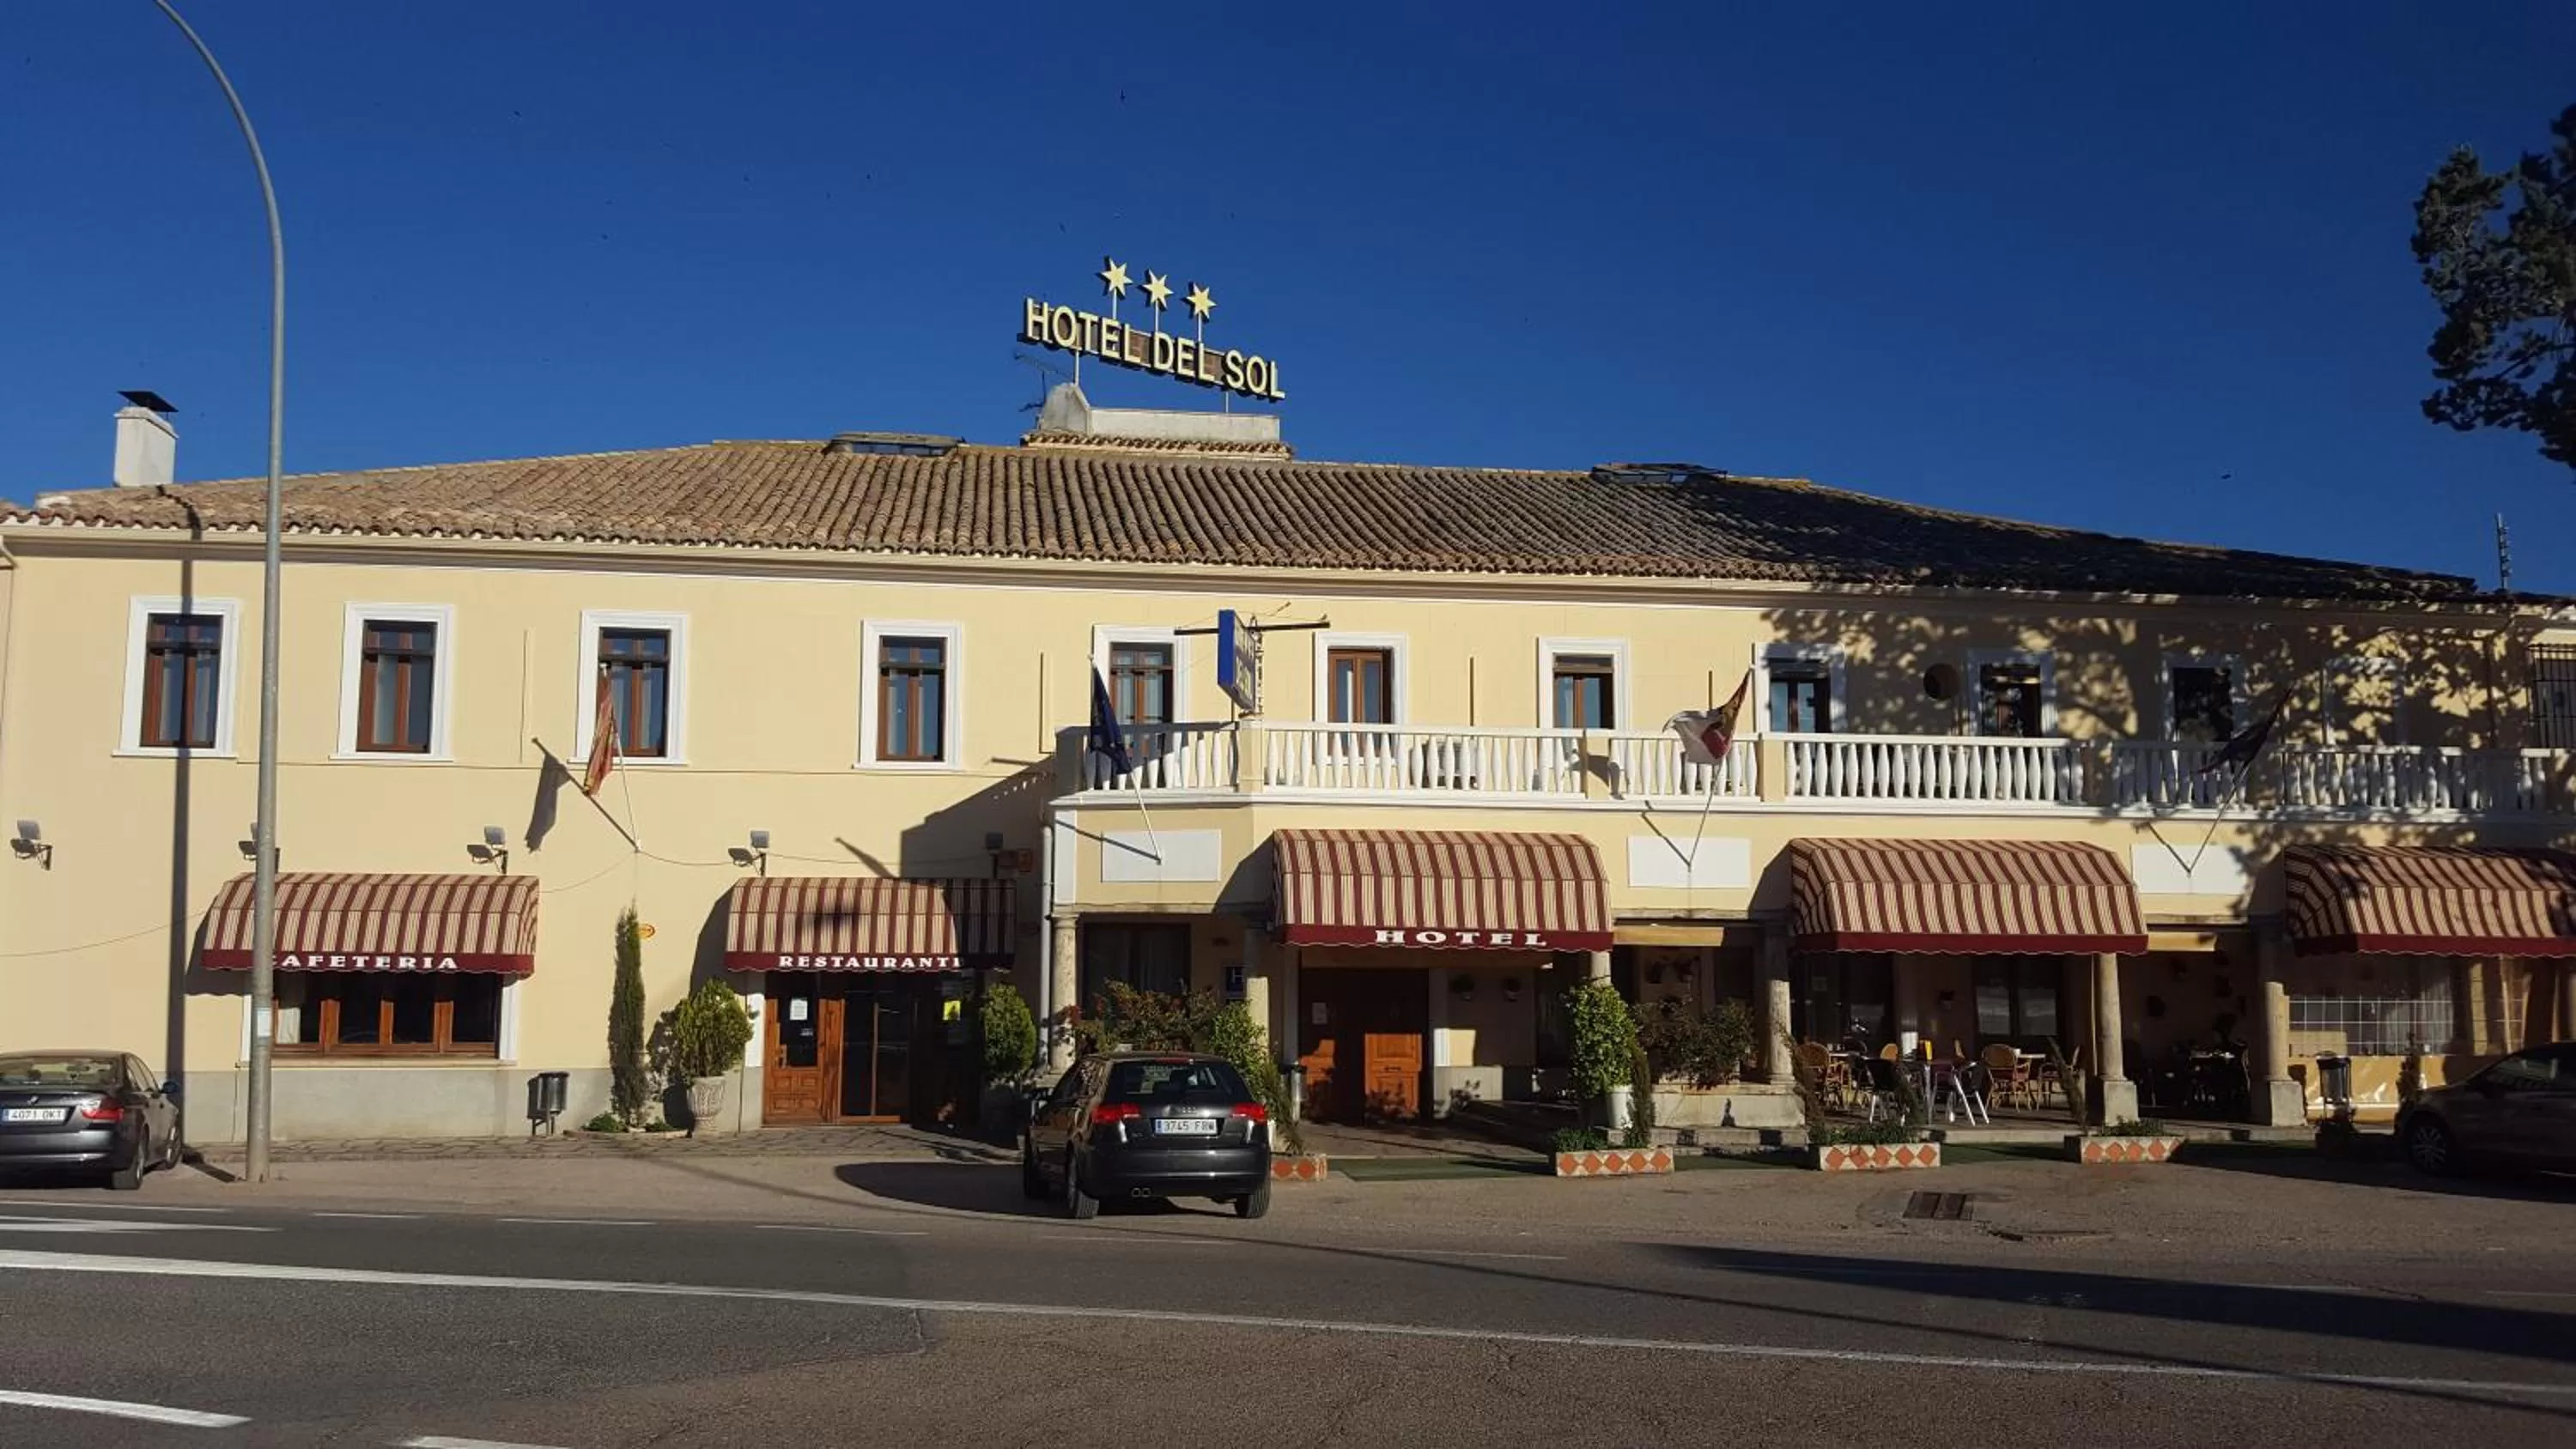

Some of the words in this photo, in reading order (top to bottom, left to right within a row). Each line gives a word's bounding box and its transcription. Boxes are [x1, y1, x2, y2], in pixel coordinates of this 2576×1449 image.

[1026, 298, 1141, 364] HOTEL
[1153, 331, 1216, 382] DEL
[1225, 349, 1285, 399] SOL
[1375, 930, 1547, 946] HOTEL
[272, 955, 459, 969] AFETERIA
